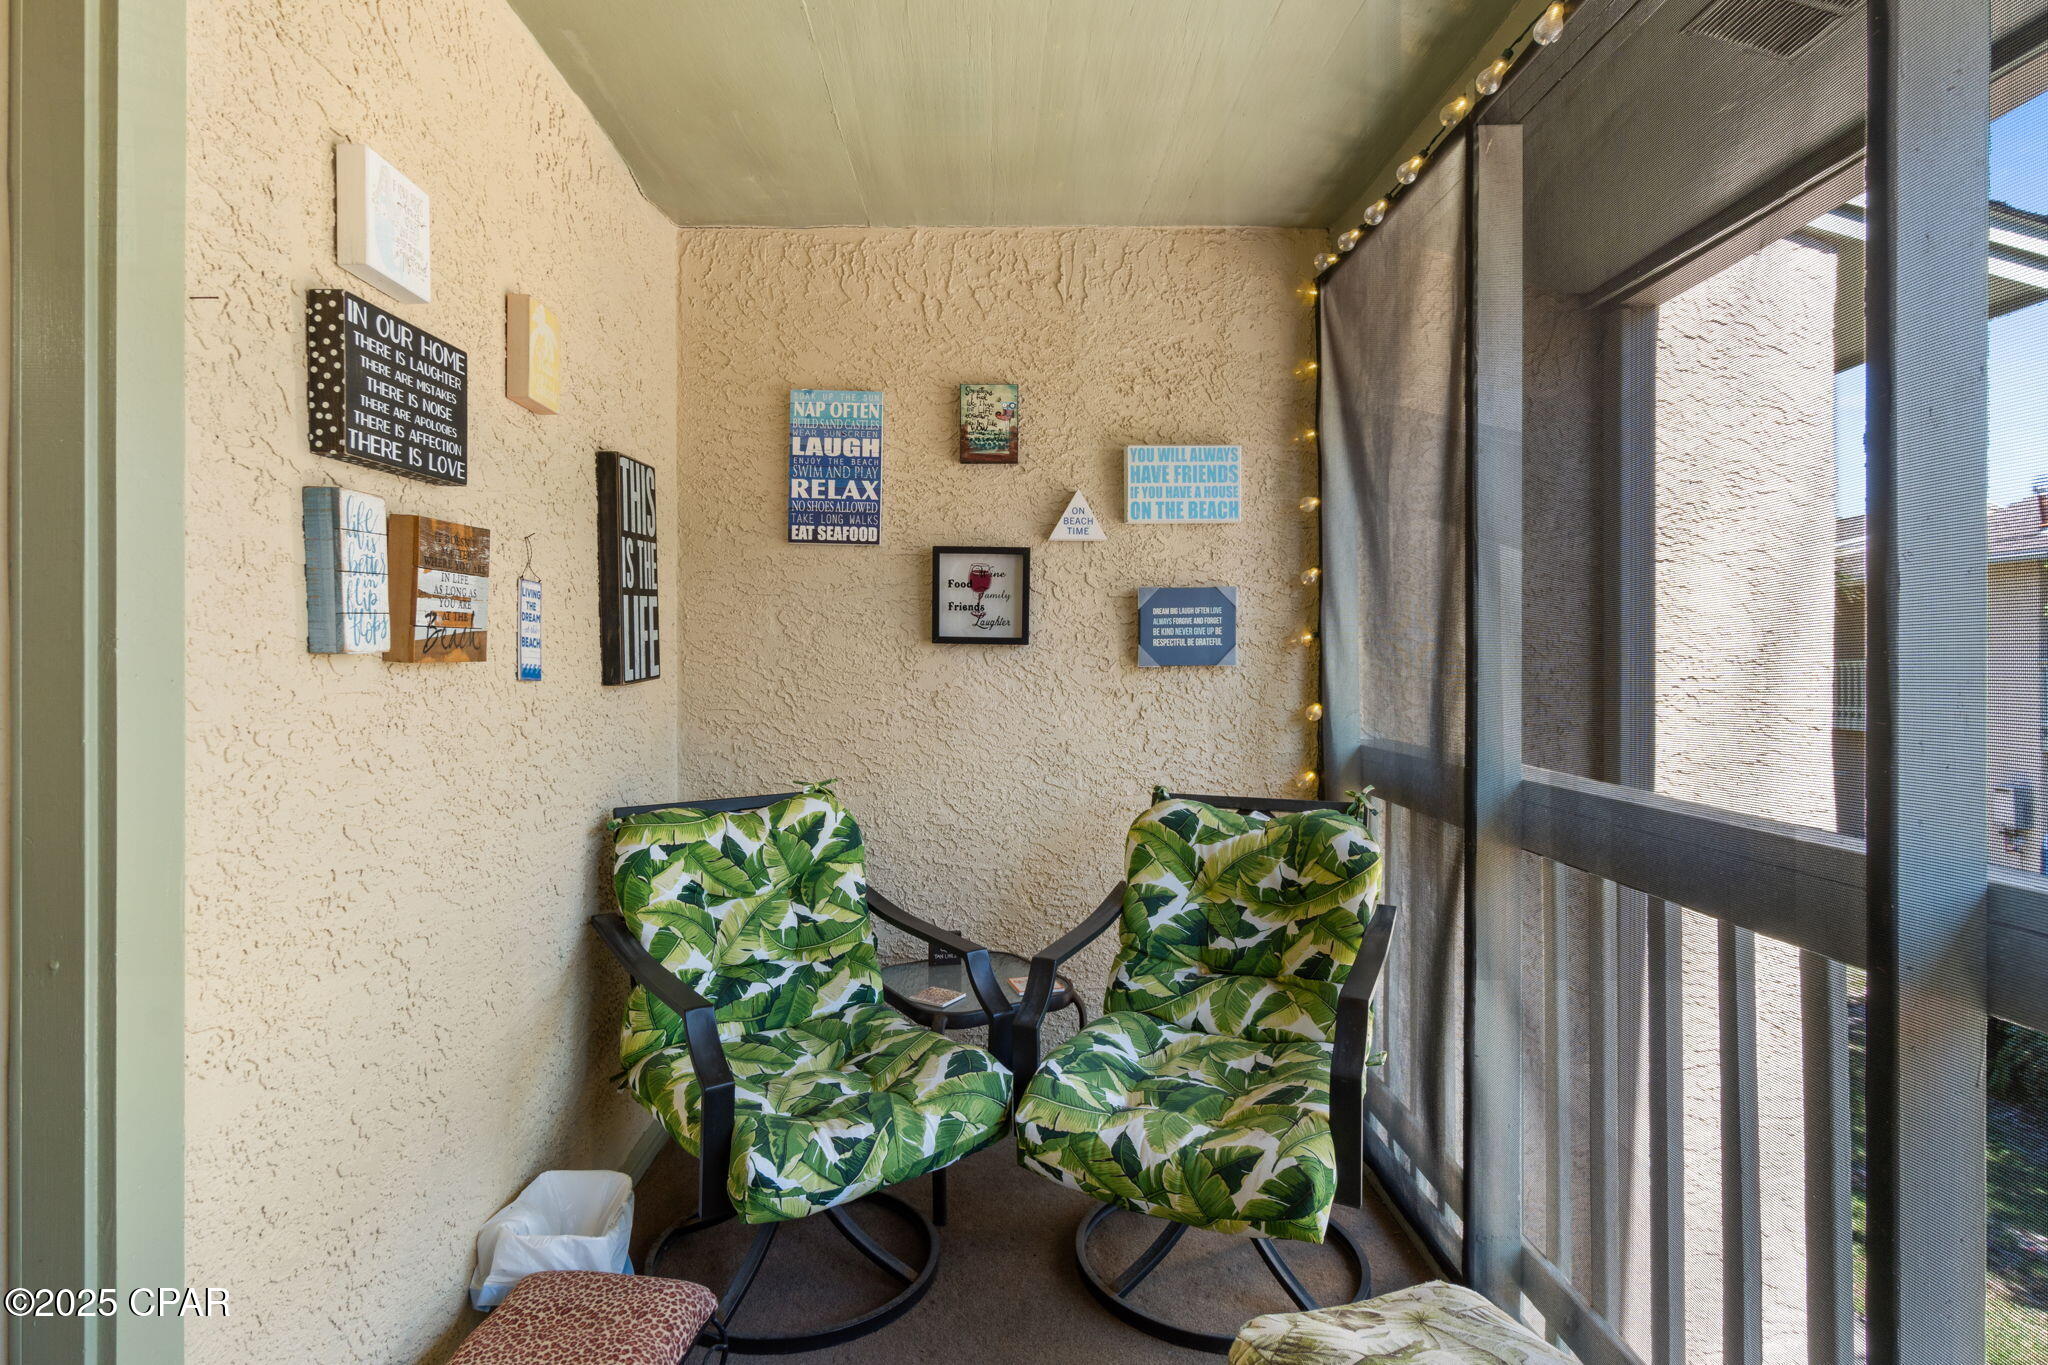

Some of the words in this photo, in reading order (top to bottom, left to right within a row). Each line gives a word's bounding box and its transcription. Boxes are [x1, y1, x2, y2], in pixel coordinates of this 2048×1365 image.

[348, 298, 368, 329] IN
[376, 314, 413, 351] OUR
[420, 335, 465, 375] HOME
[353, 330, 391, 360] THERE
[395, 350, 406, 366] IS
[410, 357, 462, 390] LAUGHTER
[360, 354, 391, 377] THERE
[394, 370, 413, 388] ARE
[416, 379, 457, 404] MISTAKES
[366, 376, 404, 404] THERE
[408, 393, 418, 409] IS
[422, 398, 452, 422] NOISE
[822, 393, 833, 401] UP
[840, 393, 856, 401] THE
[863, 393, 880, 402] SUN
[360, 394, 390, 415] THERE
[393, 406, 411, 423] ARE
[414, 415, 457, 438] APOLOGIES
[793, 401, 826, 418] NAP
[829, 402, 880, 419] OFTEN
[792, 418, 818, 429] BUILD
[819, 418, 843, 430] SAND
[844, 419, 880, 431] CASTLES
[353, 409, 390, 435] THERE
[394, 424, 405, 439] IS
[409, 429, 462, 457] AFFECTION
[792, 429, 817, 437] WEAR
[823, 430, 878, 438] SUNSCREEN
[348, 428, 402, 462] THERE
[409, 446, 422, 468] IS
[429, 452, 465, 480] LOVE
[792, 437, 880, 457] LAUGH
[793, 457, 821, 465] ENJOY
[828, 458, 844, 466] THE
[851, 458, 879, 466] BEACH
[1130, 447, 1155, 462] YOU
[1157, 447, 1188, 462] WILL
[1189, 447, 1238, 462] ALWAYS
[792, 465, 823, 478] SWIM
[825, 466, 851, 479] AND
[854, 466, 879, 479] PLAY
[1130, 464, 1170, 484] HAVE
[1173, 464, 1239, 484] FRIENDS
[791, 478, 879, 500] RELAX
[1130, 486, 1140, 498] IF
[1142, 486, 1163, 498] YOU
[1165, 486, 1192, 498] HAVE
[1194, 486, 1202, 498] A
[1204, 486, 1239, 498] HOUSE
[619, 456, 656, 538] THIS
[792, 500, 805, 511] NO
[807, 500, 834, 512] SHOES
[835, 501, 878, 513] ALLOWED
[1072, 507, 1085, 515] ON
[1130, 501, 1152, 520] ON
[1156, 501, 1185, 520] THE
[1188, 501, 1239, 520] BEACH
[792, 513, 814, 524] TAKE
[820, 514, 844, 524] LONG
[849, 514, 879, 526] WALKS
[1063, 517, 1094, 525] BEACH
[791, 525, 815, 540] EAT
[817, 526, 878, 542] SEAFOOD
[1067, 527, 1089, 535] TIME
[364, 535, 376, 553] is
[348, 541, 386, 583] better
[423, 556, 451, 570] WHERE
[454, 560, 470, 571] YOU
[621, 536, 634, 588] IS
[637, 541, 657, 590] THE
[364, 577, 378, 589] in
[441, 572, 451, 583] IN
[452, 574, 470, 586] LIFE
[948, 579, 973, 588] Food
[346, 576, 379, 620] flip
[433, 584, 444, 595] AS
[444, 585, 467, 598] LONG
[468, 588, 477, 598] AS
[521, 587, 541, 600] LIVING
[439, 598, 456, 609] YOU
[457, 600, 473, 610] ARE
[526, 602, 538, 612] THE
[948, 602, 985, 612] Friends
[1152, 607, 1170, 615] DREAM
[1194, 606, 1210, 614] OFTEN
[1210, 606, 1222, 614] LOVE
[441, 611, 451, 622] AT
[452, 612, 469, 622] THE
[521, 611, 541, 623] DREAM
[972, 614, 1011, 630] Laughter
[1152, 617, 1172, 625] ALWAYS
[1173, 617, 1192, 625] FORGIVE
[1204, 616, 1222, 624] FORGET
[353, 608, 388, 646] flops
[1152, 628, 1160, 636] BE
[1161, 628, 1174, 636] KIND
[1174, 628, 1192, 636] NEVER
[1193, 627, 1206, 636] GIVE
[1207, 627, 1214, 635] UP
[1215, 627, 1222, 635] BE
[521, 636, 541, 648] BEACH
[623, 594, 659, 682] LIFE
[1152, 638, 1187, 647] RESPECTFUL
[1187, 638, 1195, 646] BE
[1196, 638, 1222, 646] GRATEFUL
